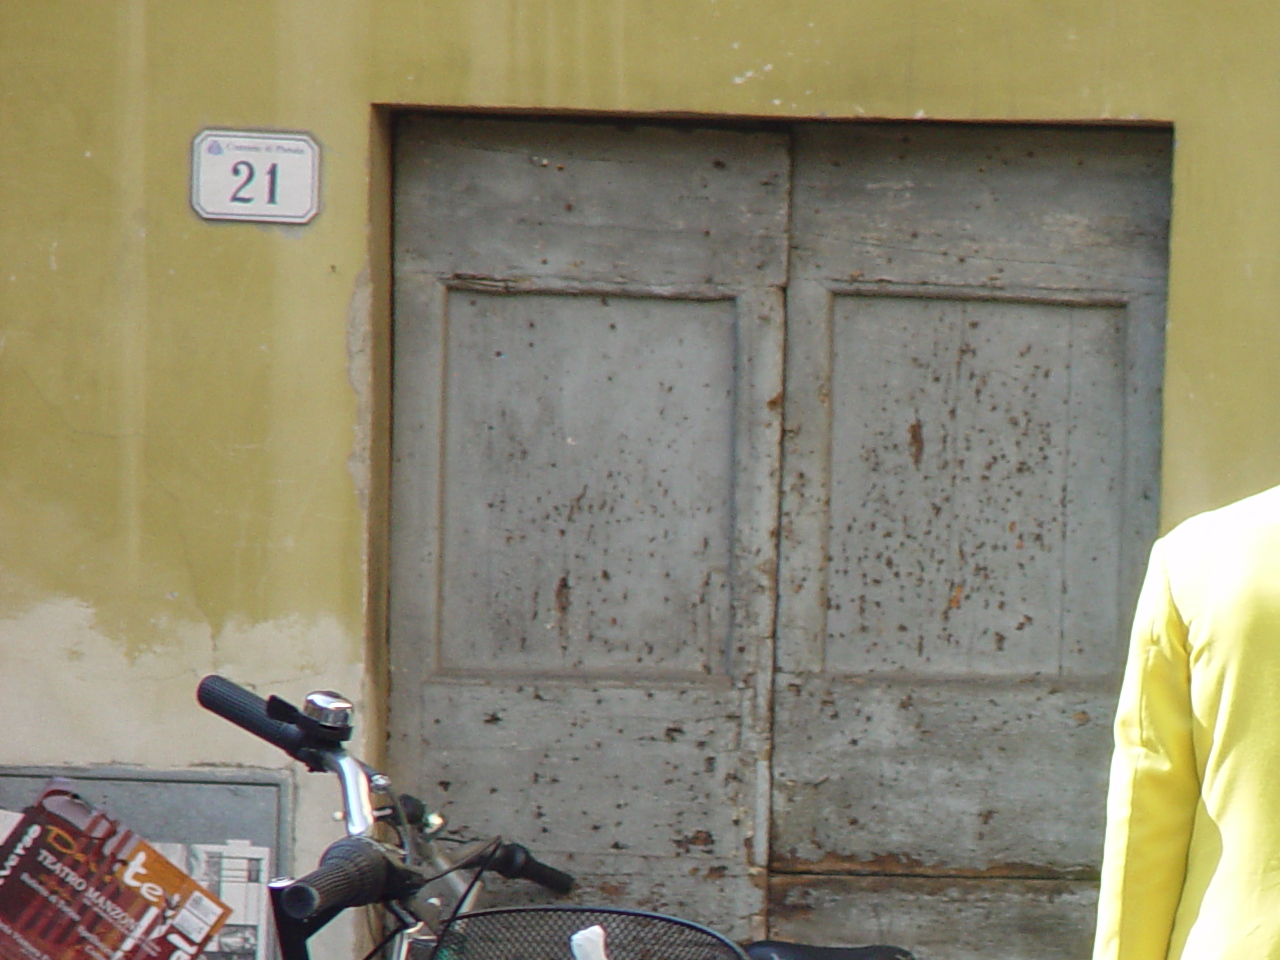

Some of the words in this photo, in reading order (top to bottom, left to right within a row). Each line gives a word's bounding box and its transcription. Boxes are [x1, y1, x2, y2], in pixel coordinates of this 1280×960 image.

[229, 160, 278, 205] 21
[37, 847, 87, 891] TEATRO
[84, 884, 141, 931] MANZON
